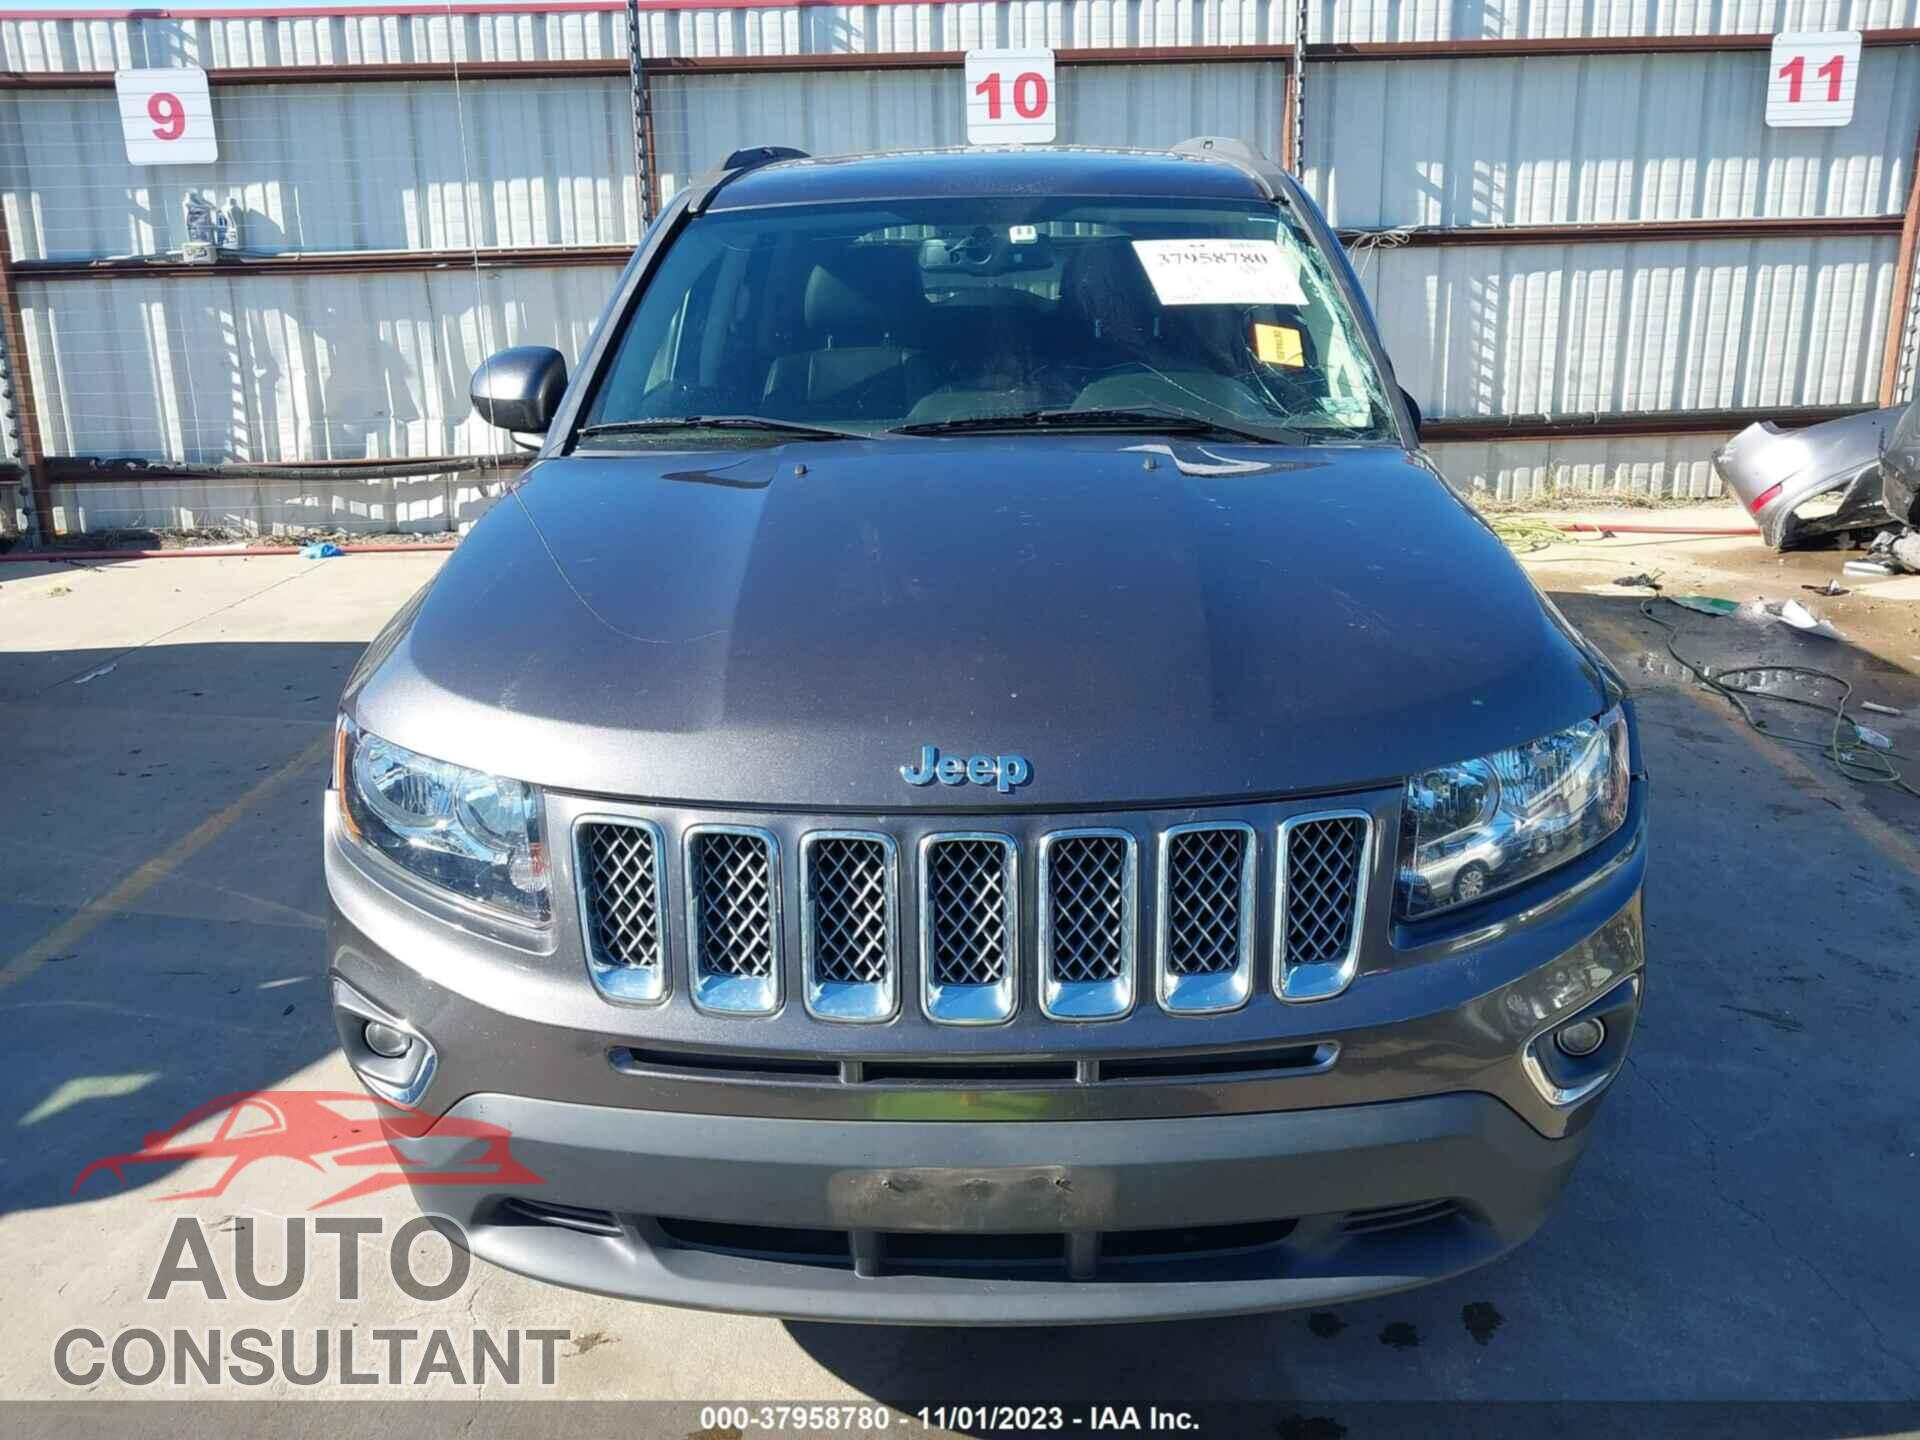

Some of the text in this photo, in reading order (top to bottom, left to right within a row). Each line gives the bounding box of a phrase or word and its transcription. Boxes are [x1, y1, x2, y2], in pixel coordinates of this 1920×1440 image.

[976, 72, 1048, 119] 10
[1778, 55, 1844, 102] 11
[147, 92, 185, 140] 9
[1157, 252, 1269, 266] 37958780
[900, 745, 1028, 792] Jeep
